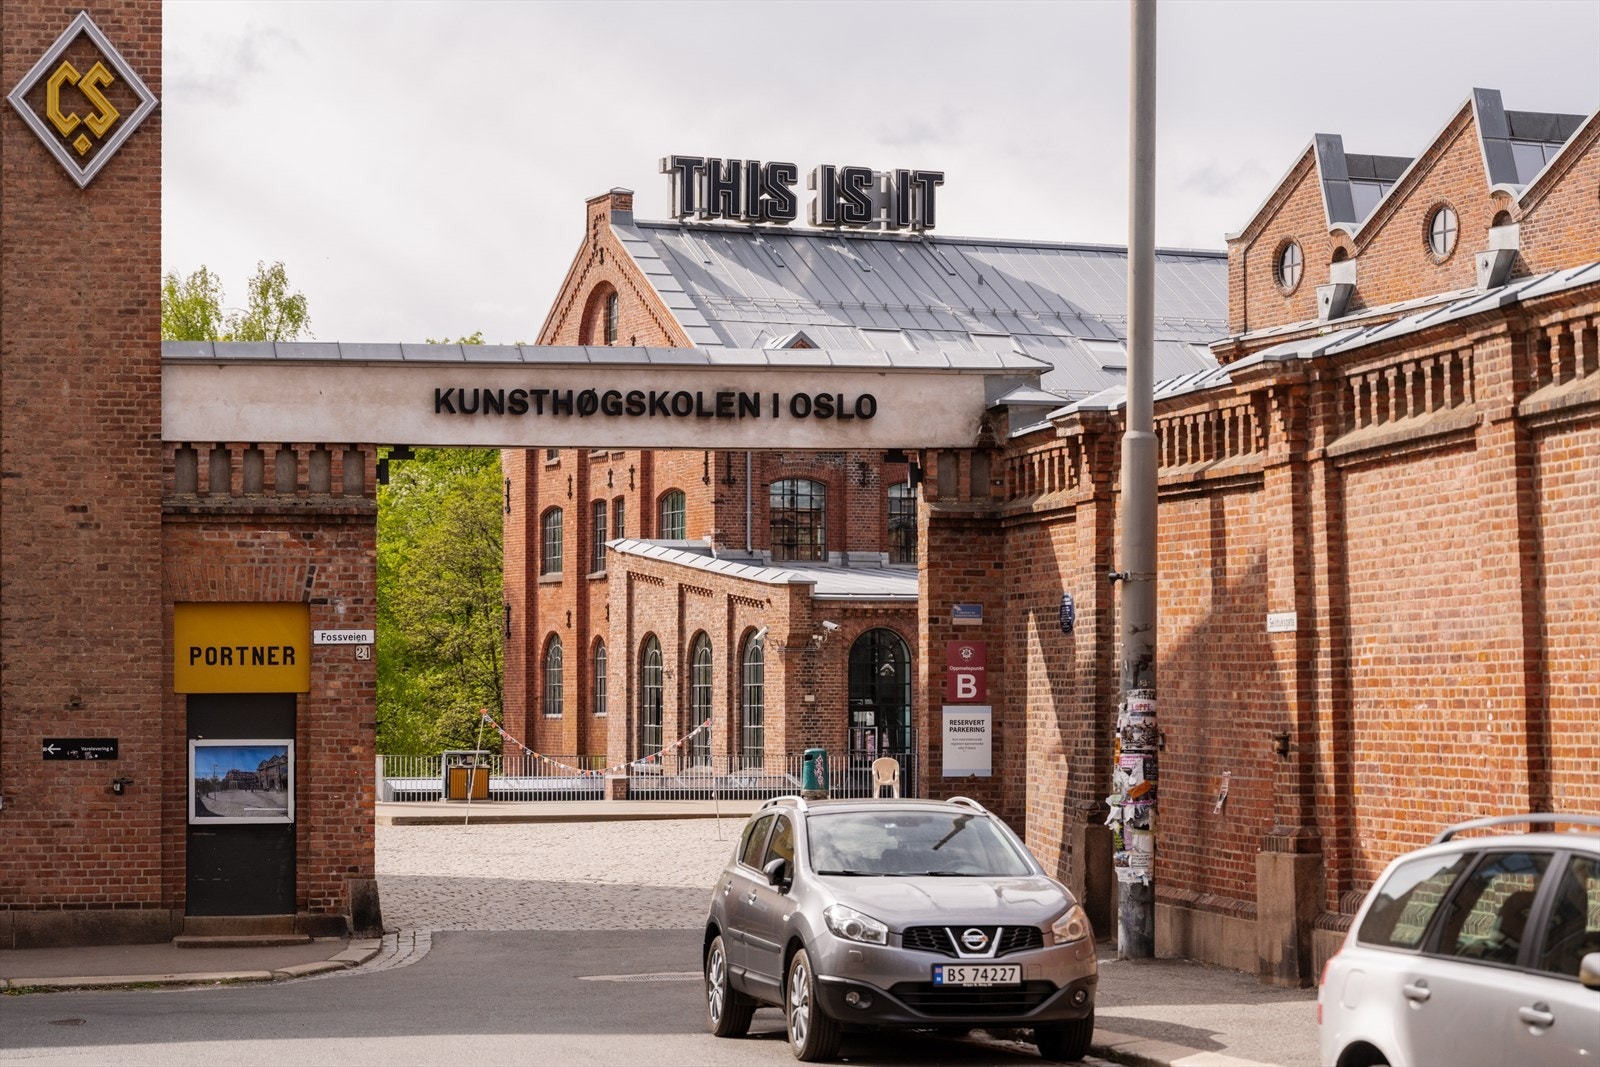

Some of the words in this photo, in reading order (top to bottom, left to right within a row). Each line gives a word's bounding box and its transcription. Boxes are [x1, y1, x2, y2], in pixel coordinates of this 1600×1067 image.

[668, 155, 798, 223] THIS
[814, 164, 874, 226] IS
[892, 168, 945, 230] IT
[434, 387, 760, 418] KUNSTHØGSKOLEN
[772, 392, 780, 419] I
[789, 392, 878, 420] OSLO
[321, 632, 367, 642] Fossveien
[189, 645, 296, 667] PORTNER
[956, 673, 978, 699] B
[948, 968, 965, 982] BS
[972, 967, 1016, 982] 74227
